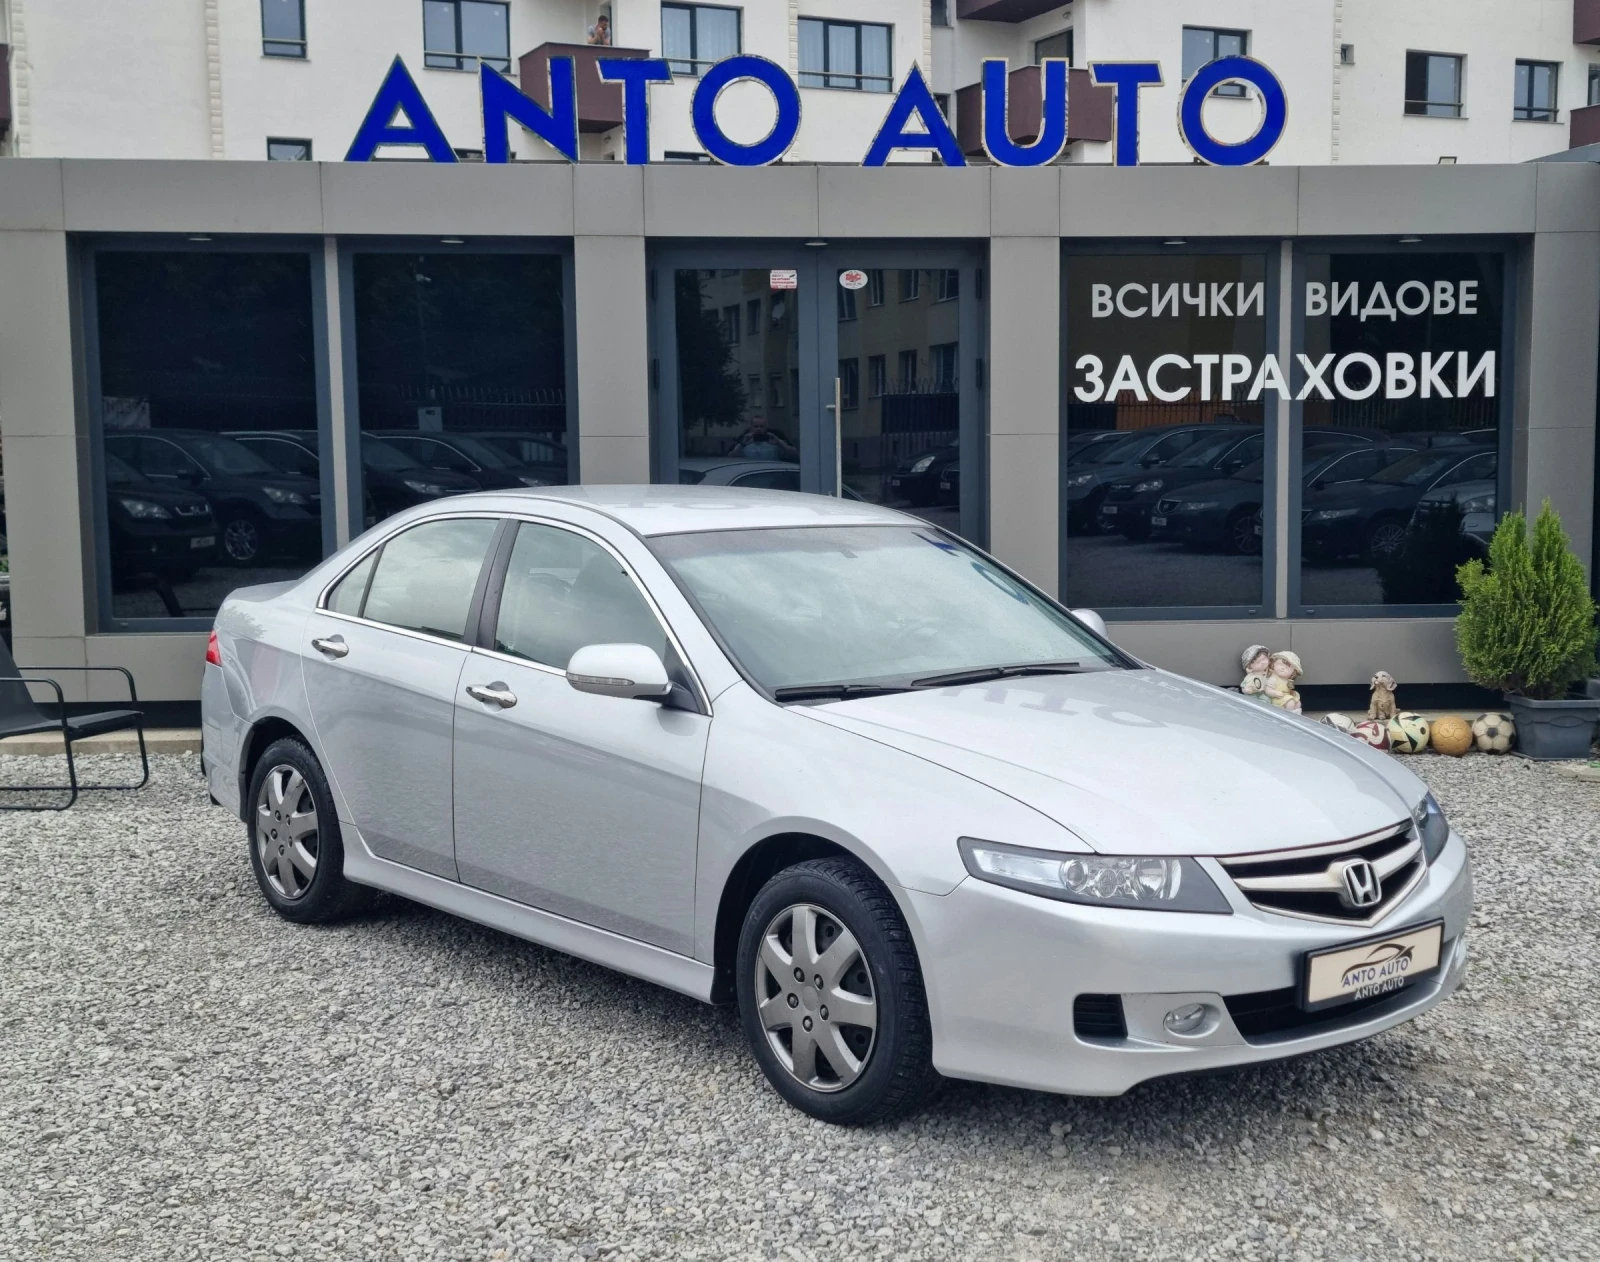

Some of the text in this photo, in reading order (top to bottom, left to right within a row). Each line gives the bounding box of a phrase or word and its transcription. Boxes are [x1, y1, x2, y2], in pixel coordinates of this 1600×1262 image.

[344, 53, 1289, 167] ANTO AUTO
[1092, 280, 1478, 322] ВСИЧКИ ВИДОВЕ
[1074, 350, 1496, 402] ЗАСТРАХОВКИ
[1342, 958, 1409, 988] ANTO AUTO
[1355, 976, 1405, 1000] ANTO AUTO
